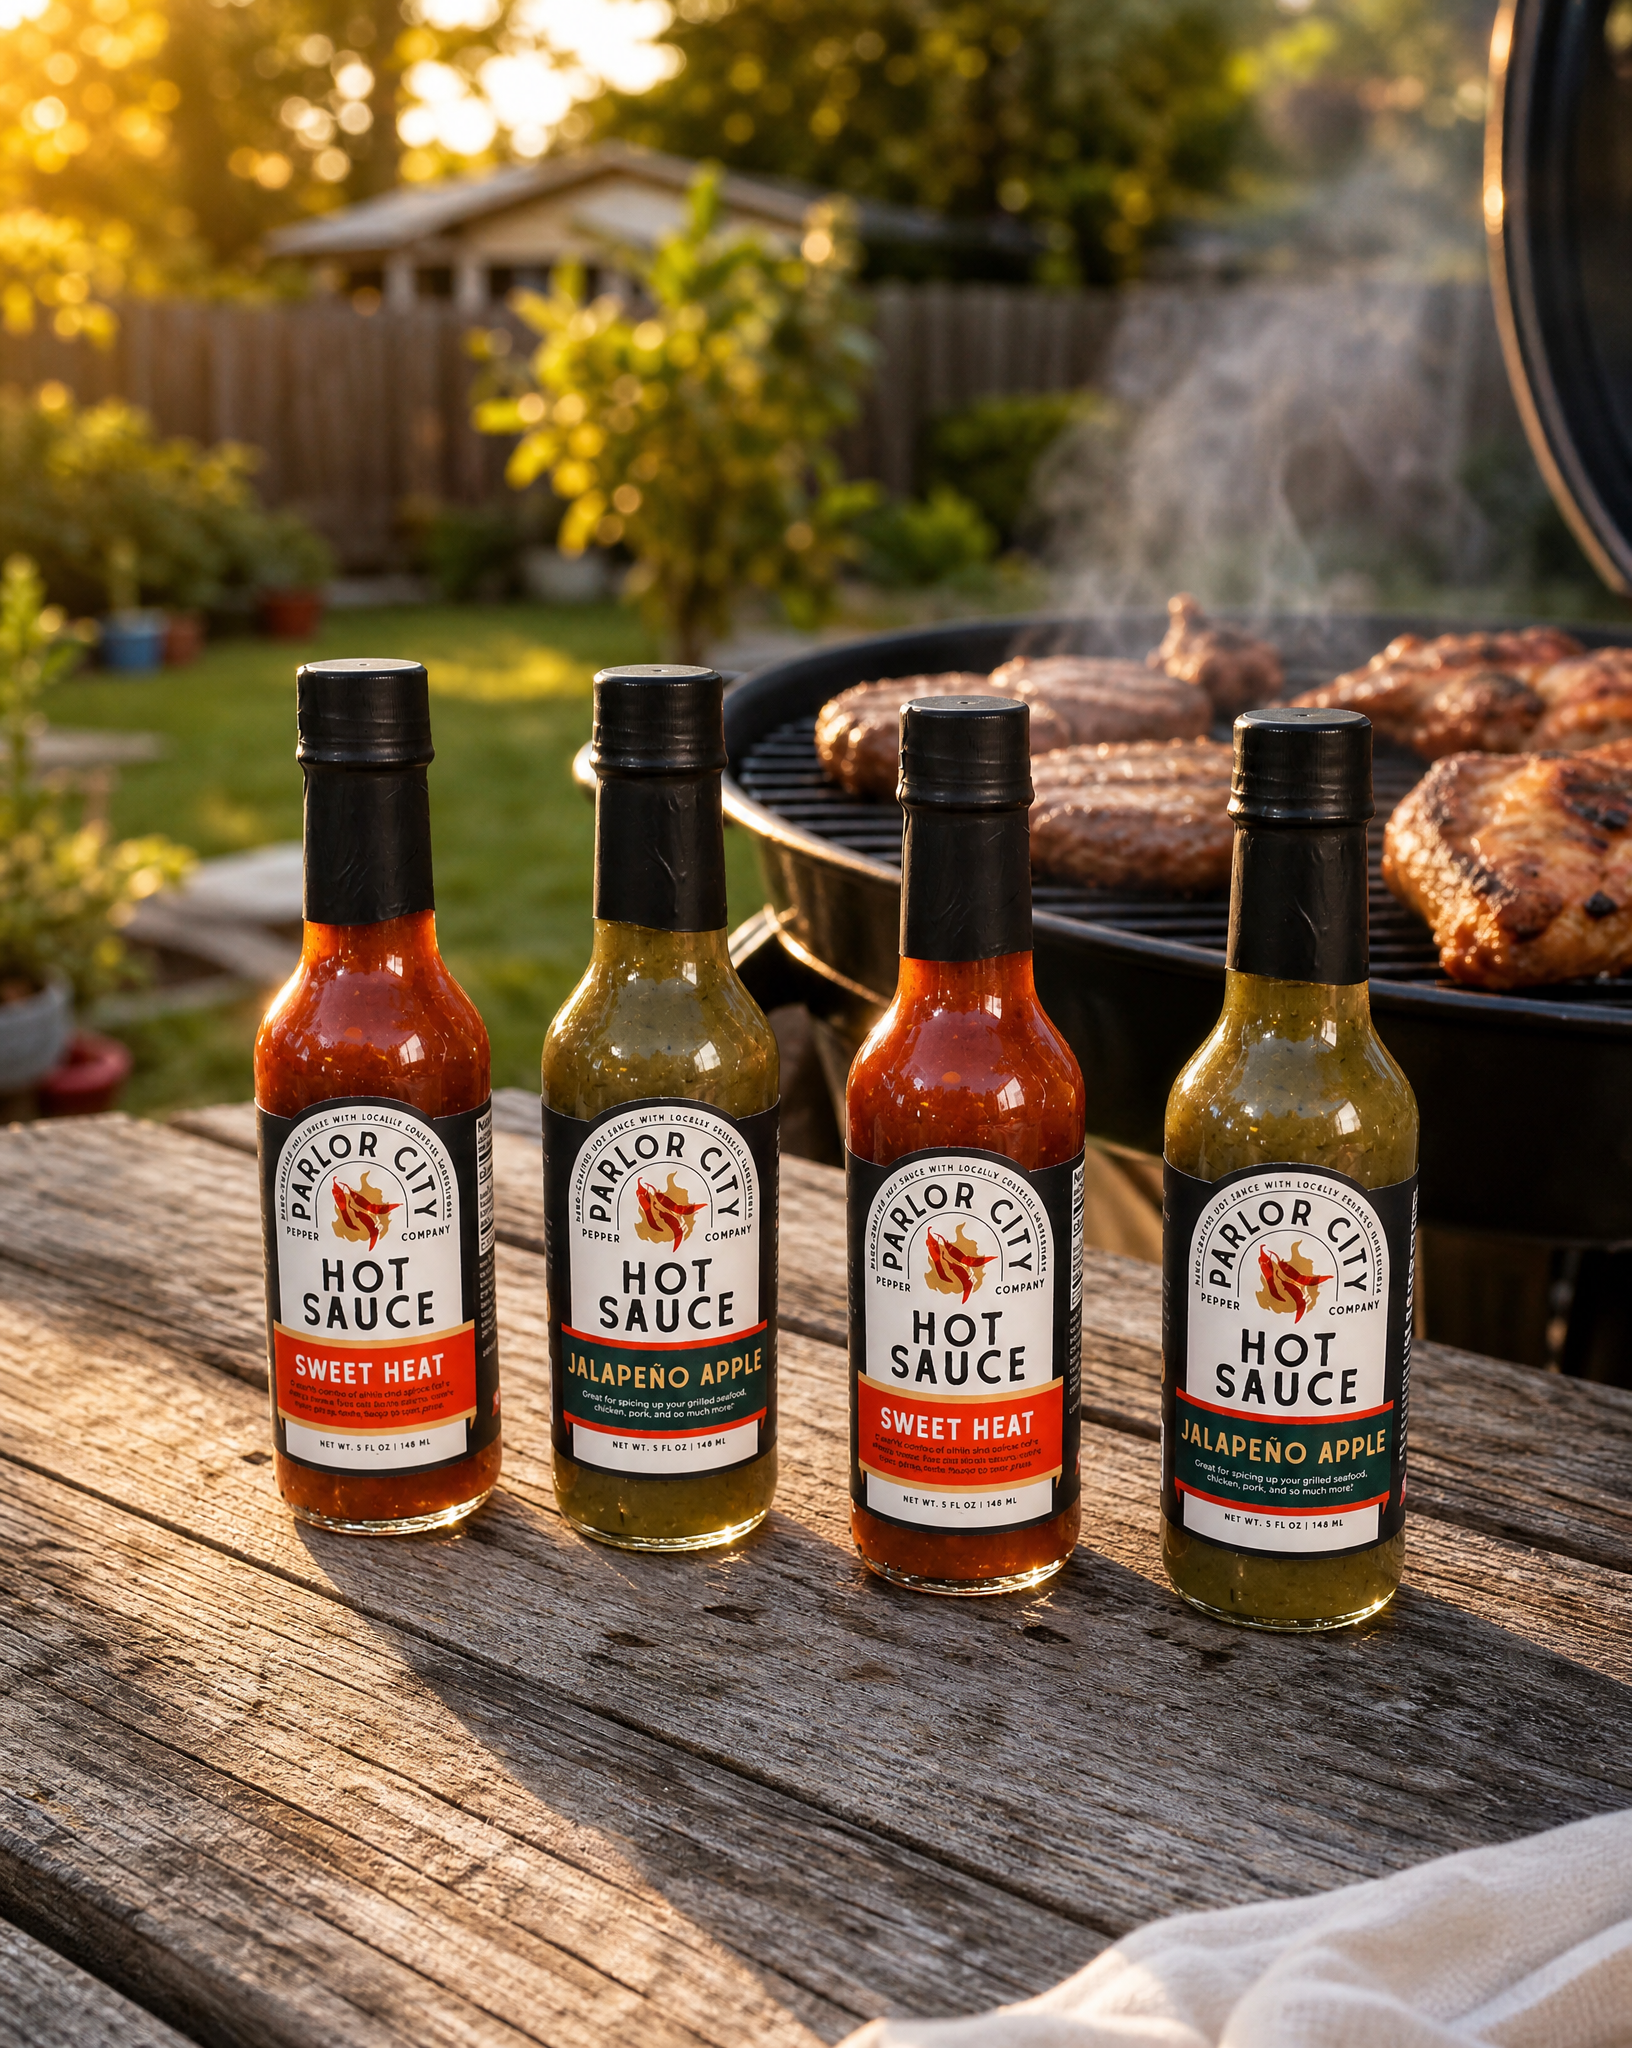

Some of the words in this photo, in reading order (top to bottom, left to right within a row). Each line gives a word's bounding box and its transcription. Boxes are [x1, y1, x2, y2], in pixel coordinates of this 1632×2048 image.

[639, 1114, 664, 1124] WITH
[291, 1131, 378, 1221] PARLOR
[394, 1146, 437, 1218] CITY
[589, 1131, 685, 1222] PARLOR
[700, 1146, 740, 1217] CITY
[929, 1164, 953, 1173] WITH
[1264, 1181, 1291, 1189] WITH
[287, 1226, 319, 1241] PEPPER
[401, 1225, 450, 1241] COMPANY
[582, 1228, 620, 1243] PEPPER
[705, 1224, 752, 1242] COMPANY
[883, 1182, 974, 1271] PARLOR
[990, 1199, 1032, 1272] CITY
[1209, 1199, 1312, 1289] PARLOR
[1327, 1217, 1368, 1292] CITY
[322, 1257, 409, 1293] HOT
[623, 1258, 712, 1295] HOT
[876, 1276, 911, 1293] PEPPER
[995, 1278, 1045, 1295] COMPANY
[303, 1290, 434, 1331] SAUCE
[599, 1291, 734, 1333] SAUCE
[1201, 1292, 1240, 1311] PEPPER
[1329, 1300, 1380, 1315] COMPANY
[913, 1310, 1003, 1347] HOT
[1241, 1328, 1336, 1368] HOT
[295, 1354, 373, 1384] SWEET
[384, 1353, 444, 1384] HEAT
[567, 1352, 690, 1389] JALAPEÑO
[700, 1348, 762, 1386] APPLE
[891, 1345, 1026, 1386] SAUCE
[582, 1390, 602, 1402] Great
[604, 1395, 616, 1404] for
[618, 1399, 649, 1409] spicing
[666, 1401, 685, 1410] your
[687, 1397, 715, 1408] grilled
[1215, 1363, 1357, 1407] SAUCE
[687, 1407, 710, 1417] much
[880, 1406, 961, 1440] SWEET
[973, 1410, 1034, 1440] HEAT
[320, 1440, 334, 1449] NET
[338, 1442, 353, 1451] WT.
[378, 1443, 390, 1451] OZ
[420, 1438, 430, 1447] ML
[612, 1440, 628, 1449] NET
[632, 1443, 650, 1451] WT.
[675, 1443, 687, 1451] OZ
[715, 1438, 726, 1446] ML
[1181, 1418, 1307, 1465] JALAPEÑO
[1318, 1429, 1386, 1464] APPLE
[1194, 1459, 1216, 1473] Great
[1217, 1466, 1230, 1476] for
[1232, 1470, 1263, 1483] spicing
[1266, 1477, 1278, 1485] up
[1280, 1477, 1300, 1486] your
[1303, 1475, 1331, 1486] grilled
[903, 1495, 918, 1504] NET
[922, 1498, 938, 1508] WT.
[950, 1501, 960, 1509] FL
[964, 1501, 976, 1509] OZ
[1006, 1497, 1017, 1505] ML
[1243, 1483, 1267, 1494] pork,
[1269, 1487, 1286, 1495] and
[1303, 1486, 1326, 1495] much
[1224, 1513, 1241, 1523] NET
[1245, 1518, 1262, 1527] WT.
[1275, 1521, 1285, 1529] FL
[1289, 1521, 1302, 1530] OZ
[1332, 1519, 1343, 1527] ML
